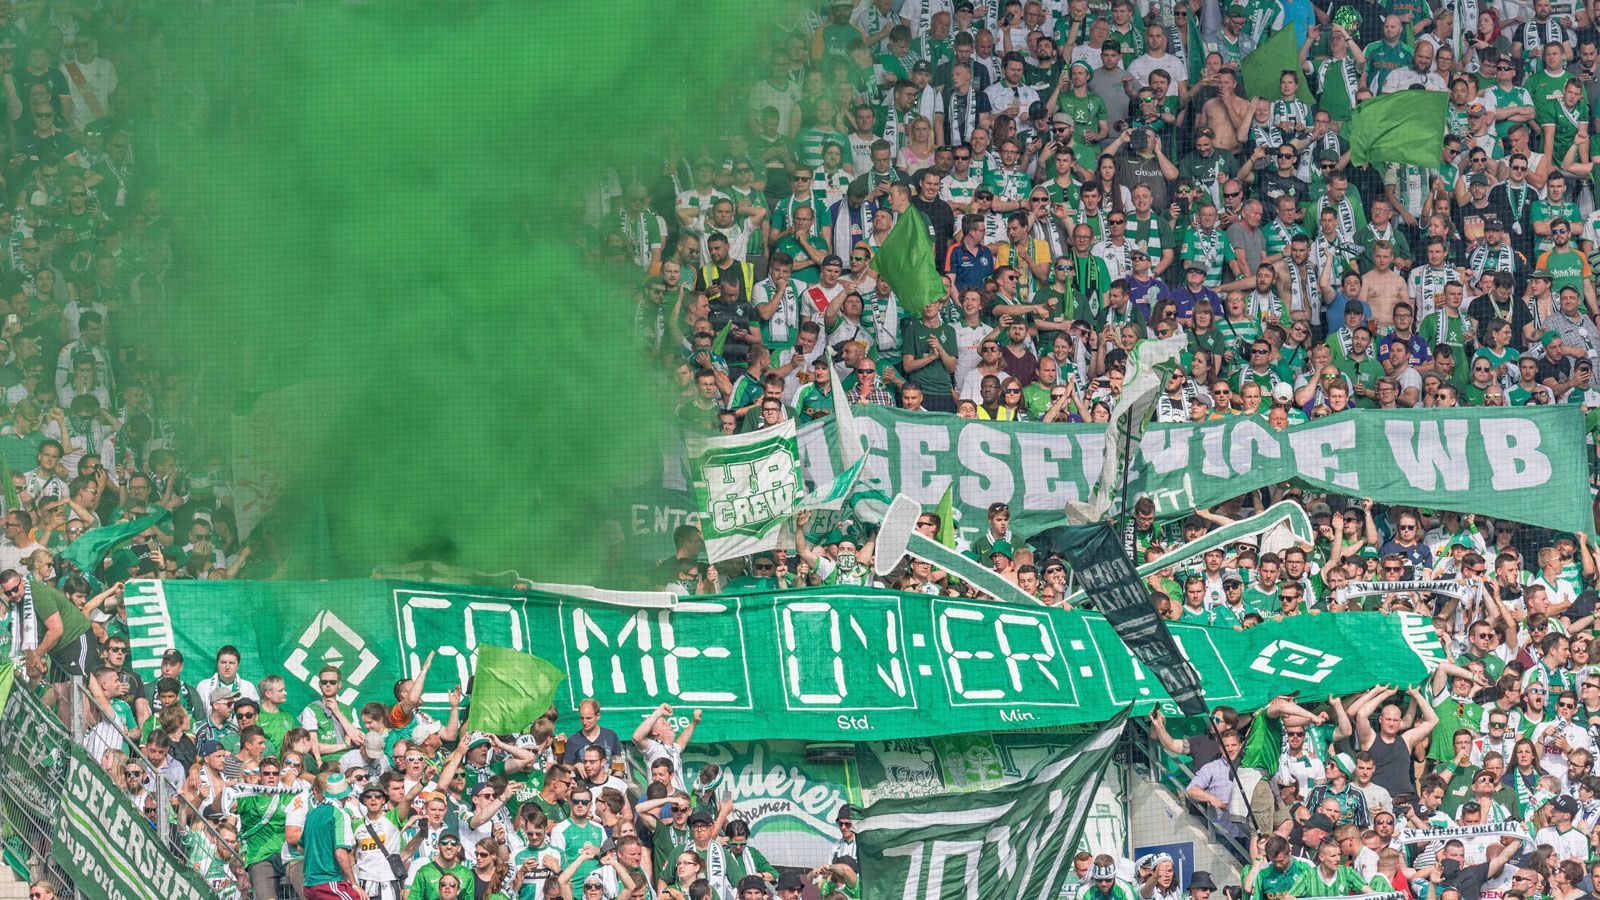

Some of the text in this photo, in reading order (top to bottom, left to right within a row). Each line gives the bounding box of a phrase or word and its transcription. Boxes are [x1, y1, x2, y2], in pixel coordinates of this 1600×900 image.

[1383, 417, 1552, 492] WB
[712, 482, 796, 533] CREW
[1355, 583, 1368, 593] SV
[837, 714, 875, 731] Std.
[1000, 708, 1041, 723] Min.
[732, 801, 791, 825] Bremen
[1403, 821, 1518, 839] SV WERDER BREMEN
